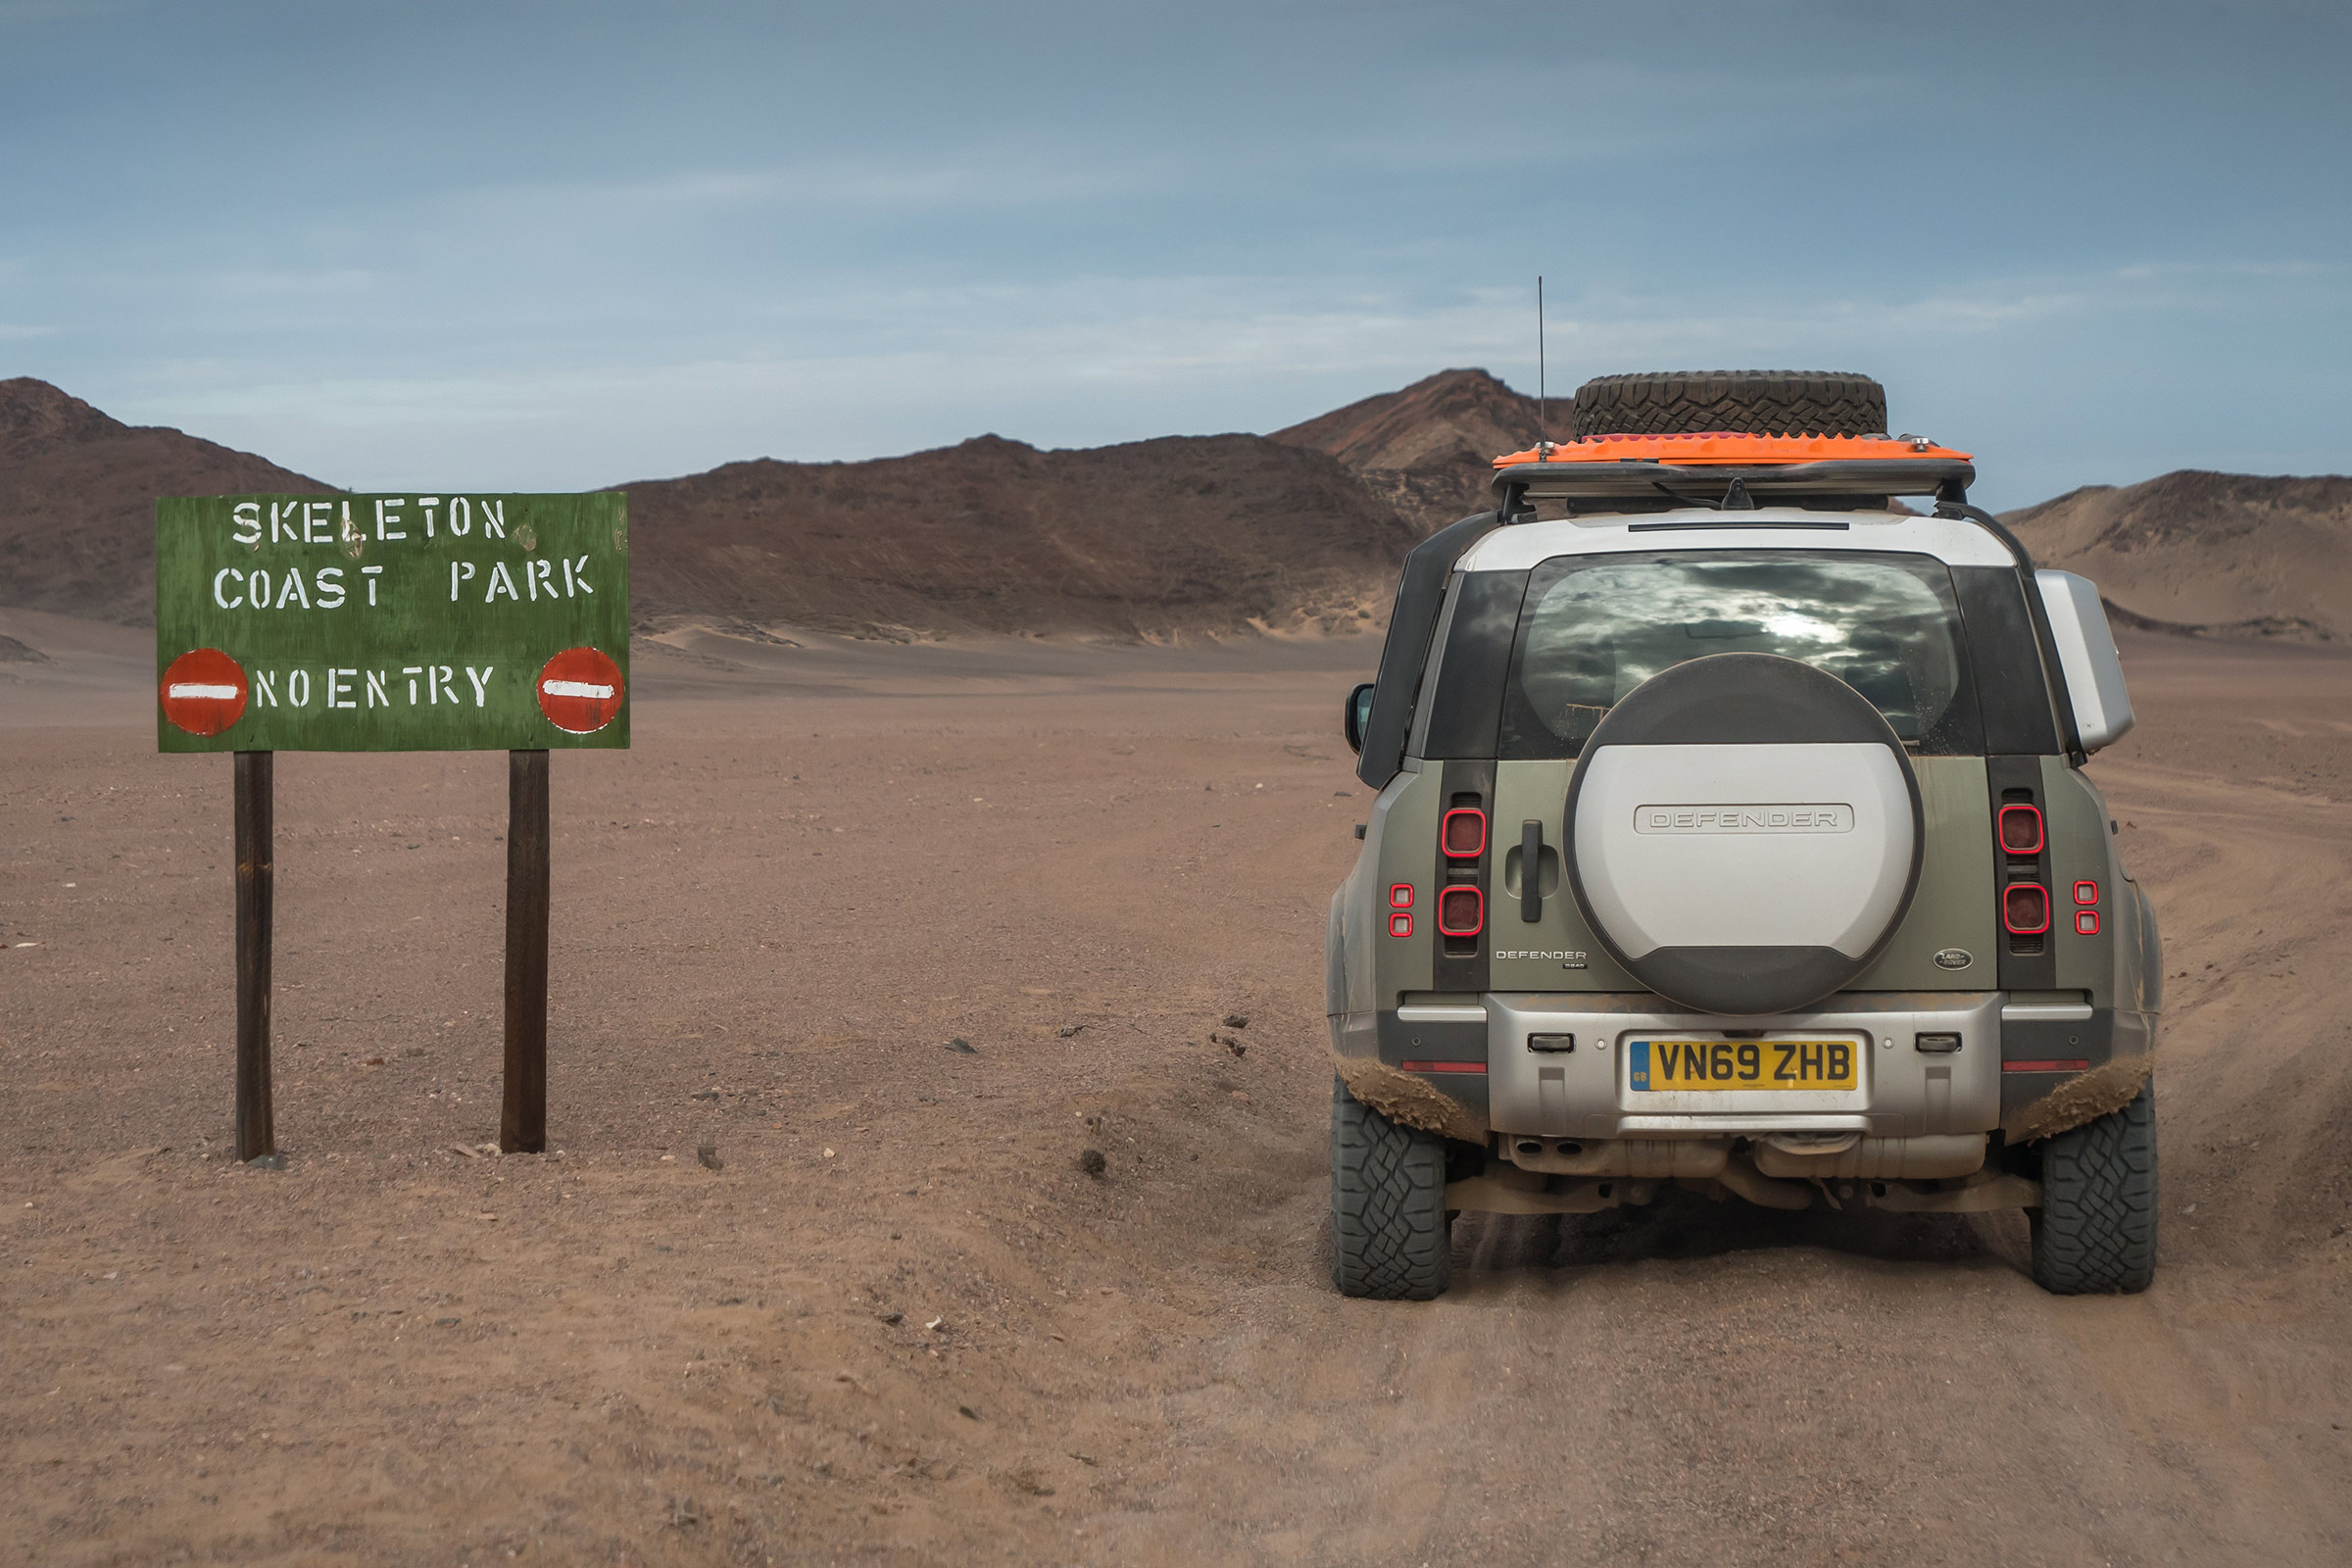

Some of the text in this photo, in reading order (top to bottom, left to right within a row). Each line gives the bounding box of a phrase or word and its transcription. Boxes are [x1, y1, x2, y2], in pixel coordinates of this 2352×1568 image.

[233, 497, 505, 543] SKELETON
[214, 555, 594, 610] COAST PARK
[257, 665, 494, 708] NO ENTRY
[1649, 810, 1838, 828] DEFENDER
[1495, 951, 1588, 959] DEFENDER
[1634, 1071, 1646, 1082] GB
[1658, 1044, 1850, 1080] VN69 ZHB
